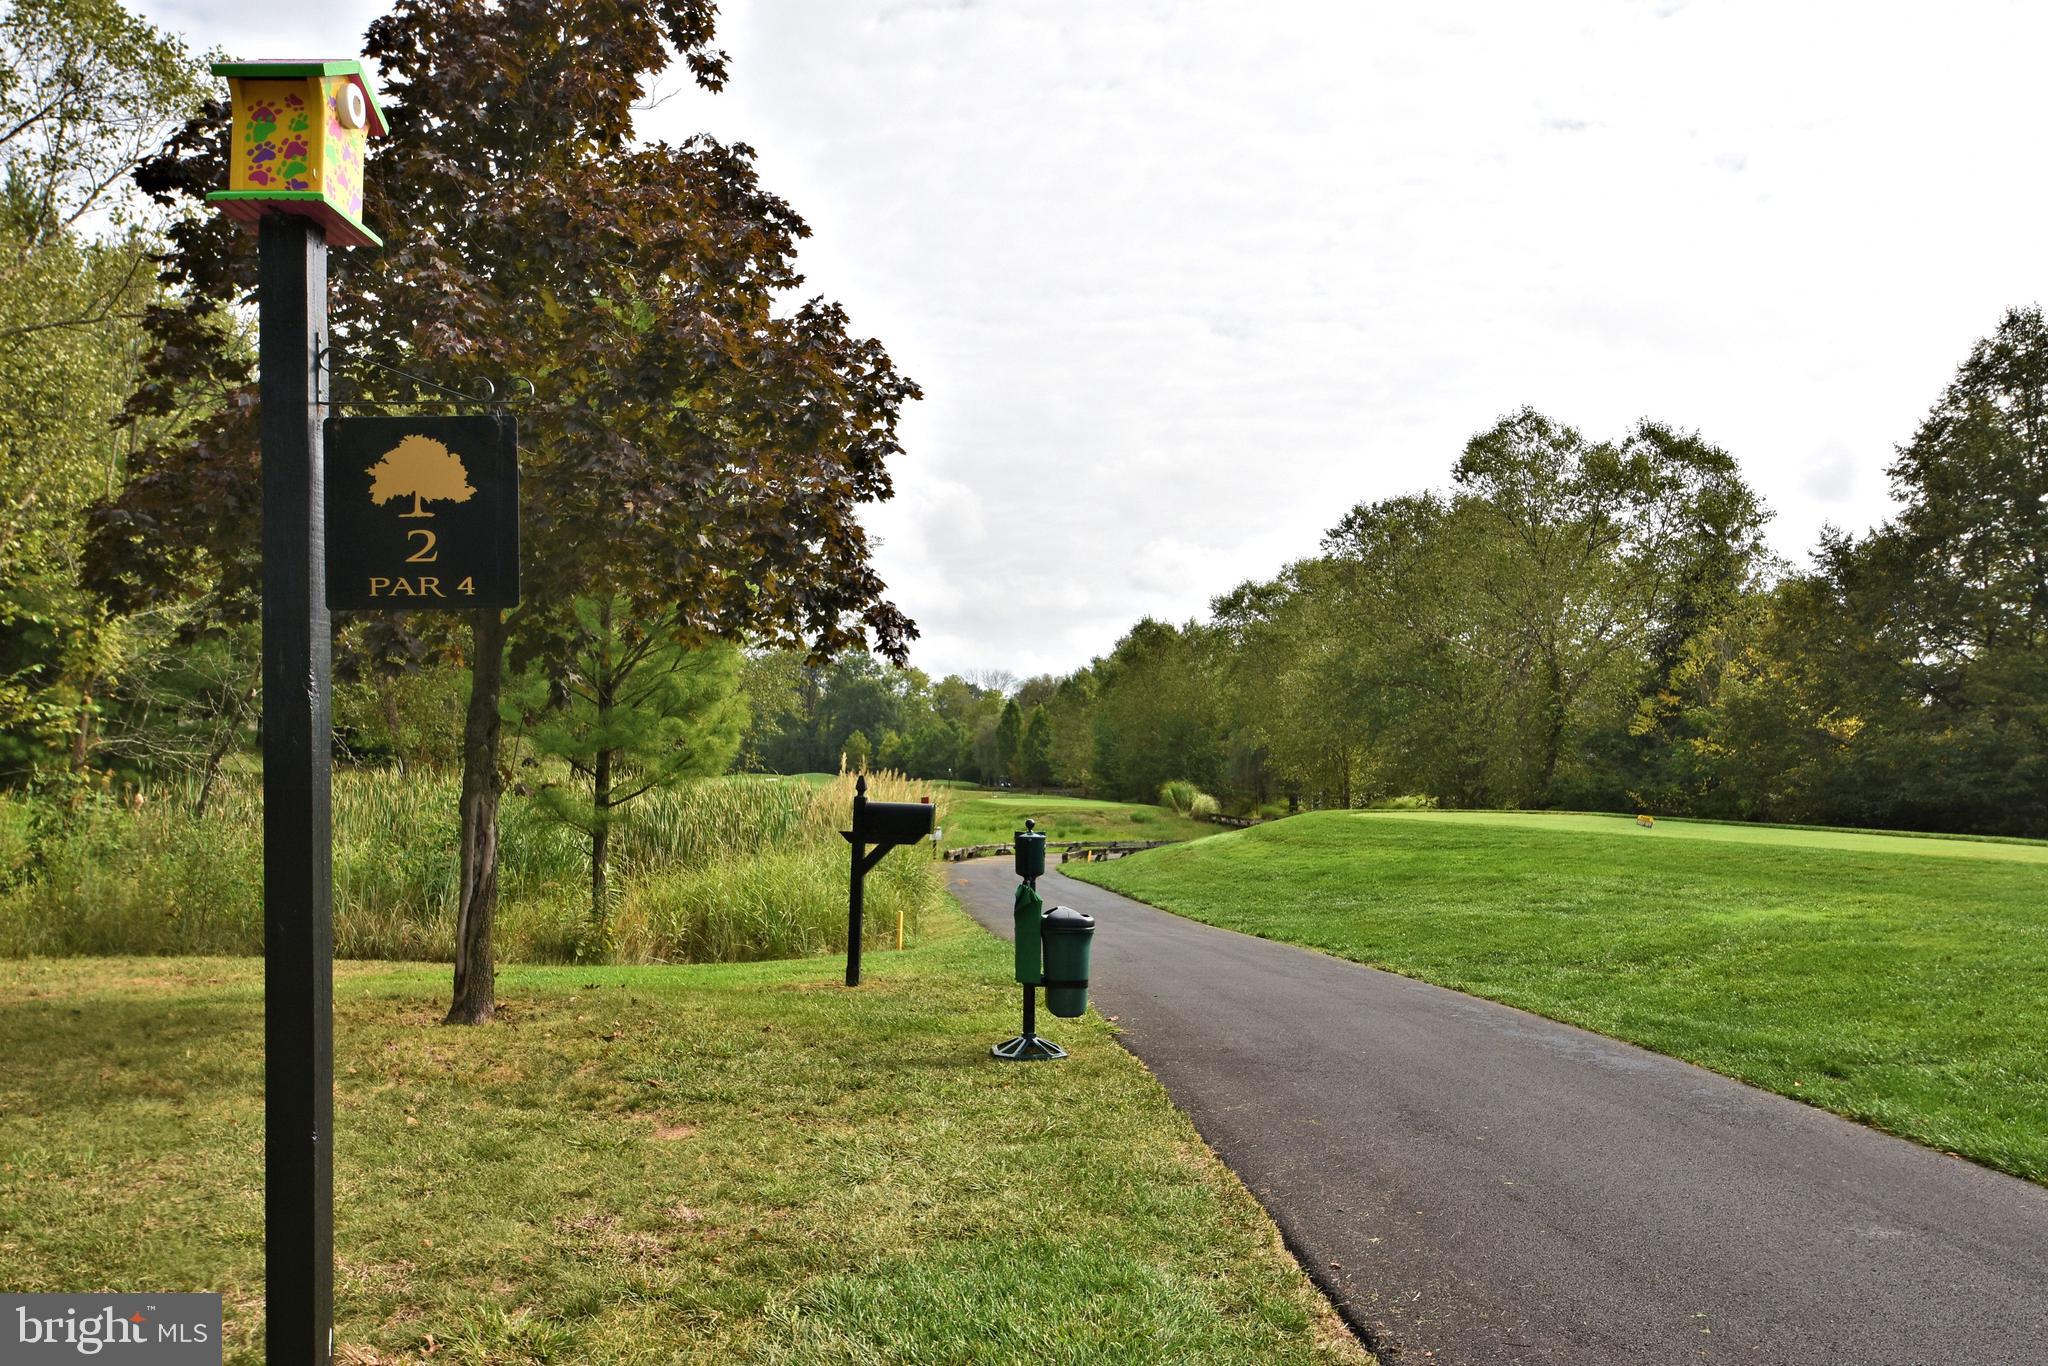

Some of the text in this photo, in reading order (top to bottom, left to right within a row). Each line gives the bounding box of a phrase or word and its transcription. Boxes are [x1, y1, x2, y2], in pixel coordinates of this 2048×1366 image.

[405, 529, 438, 563] 2
[368, 576, 476, 598] PAR 4
